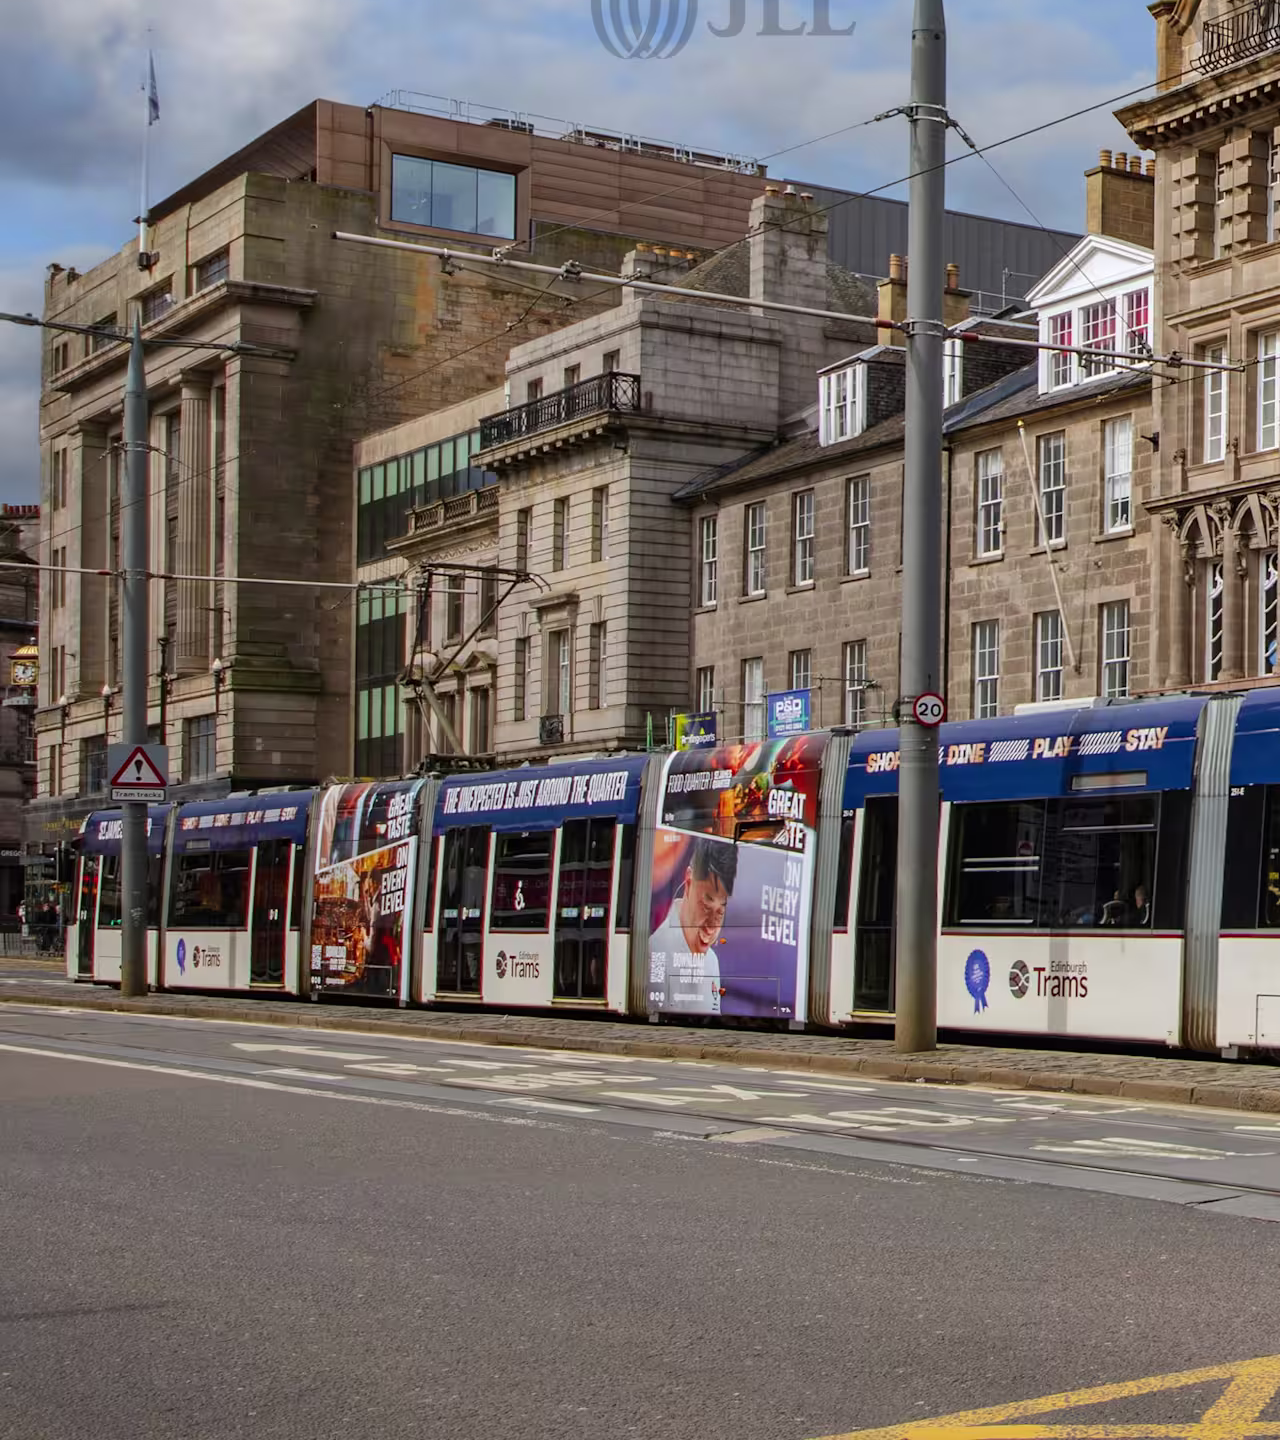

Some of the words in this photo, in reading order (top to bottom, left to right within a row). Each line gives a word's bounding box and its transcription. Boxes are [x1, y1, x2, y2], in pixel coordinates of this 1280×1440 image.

[776, 698, 802, 713] P&D
[918, 702, 941, 717] 20
[947, 743, 985, 765] DINE
[1032, 736, 1074, 759] PLAY
[1125, 727, 1168, 751] STAY
[443, 787, 460, 814] THE
[458, 783, 507, 812] UNEXPECTED
[504, 782, 515, 809] IS
[515, 780, 537, 808] JUST
[535, 776, 572, 806] AROUND
[571, 775, 589, 803] THE
[588, 771, 629, 805] QUARTER
[667, 774, 684, 793] FOOD
[388, 792, 415, 819] GREAT
[768, 789, 806, 820] GREAT
[388, 814, 411, 840] TASTE
[397, 845, 409, 868] ON
[382, 867, 408, 894] EVERY
[381, 890, 404, 916] LEVEL
[761, 885, 799, 917] EVERY
[761, 914, 797, 947] LEVEL
[201, 949, 221, 967] Trams
[509, 955, 540, 978] Trams
[1050, 960, 1088, 975] Edinburgh
[1033, 967, 1088, 998] Trams
[444, 1071, 658, 1090] BUS
